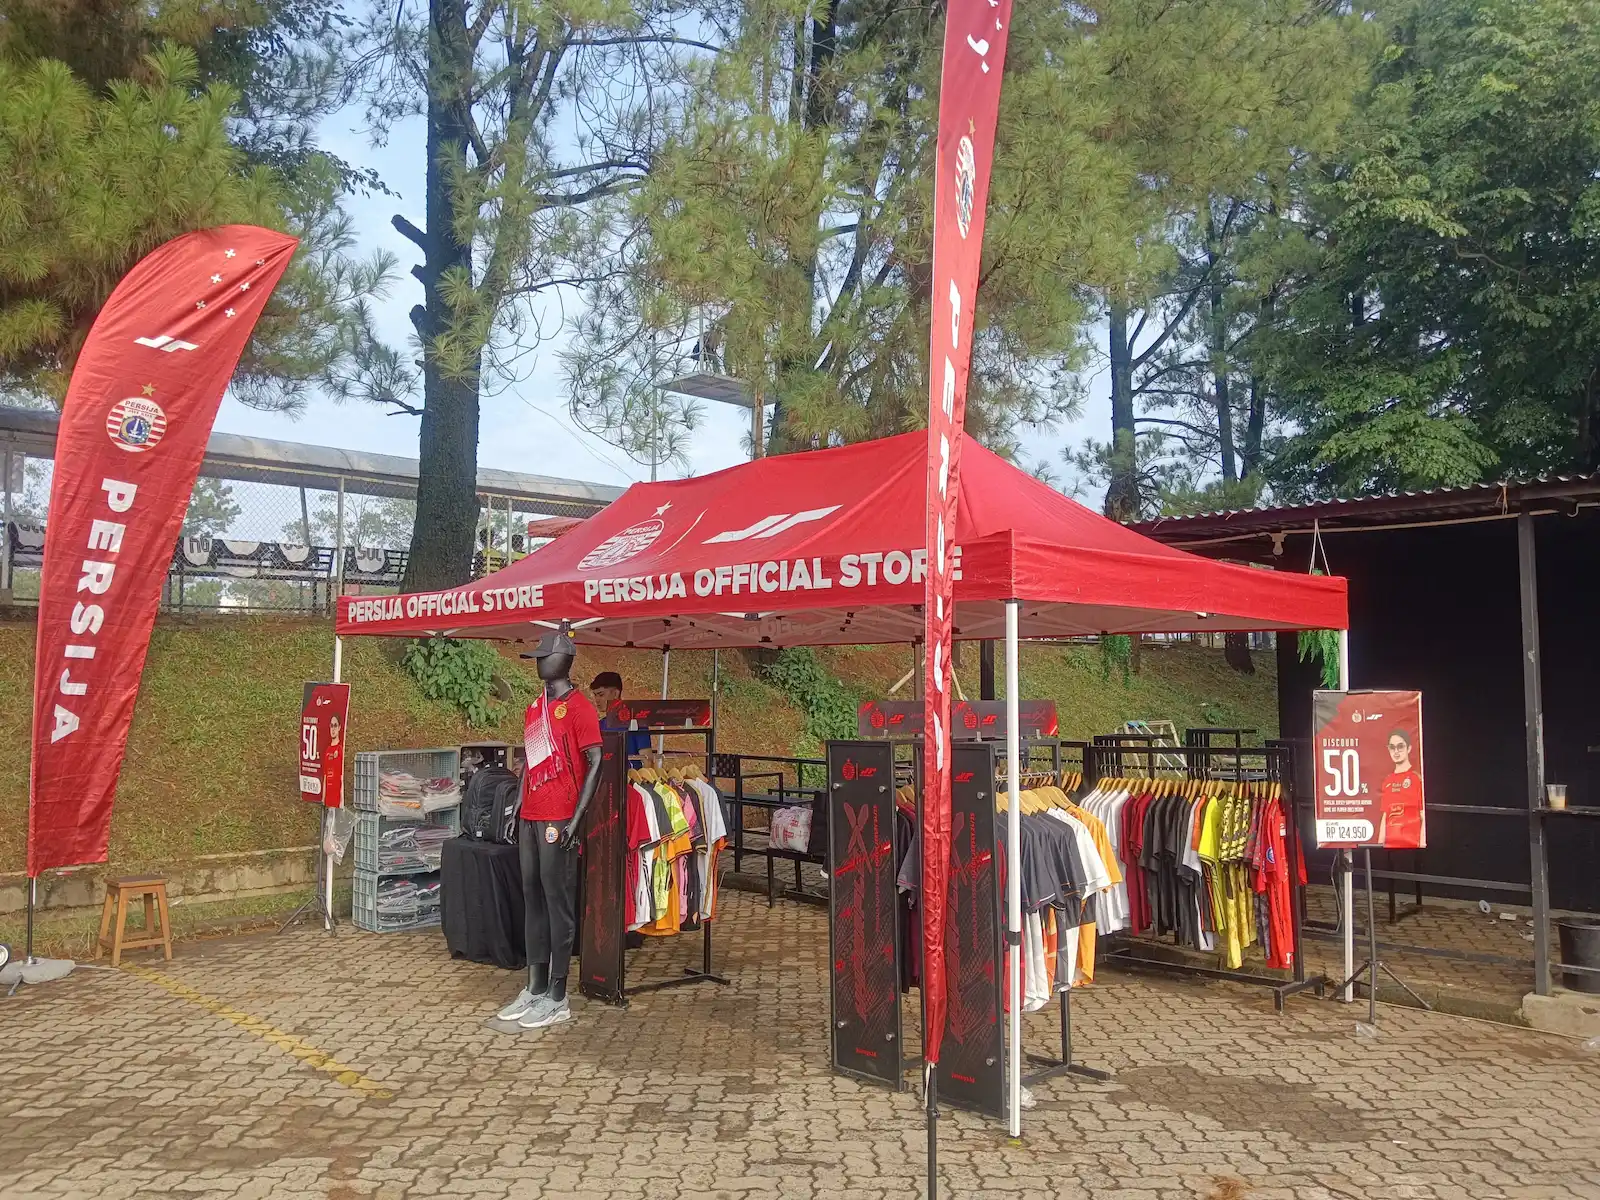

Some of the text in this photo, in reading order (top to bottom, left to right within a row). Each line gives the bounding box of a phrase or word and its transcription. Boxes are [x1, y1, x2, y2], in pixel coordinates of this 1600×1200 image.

[124, 400, 159, 414] PERSIJA
[584, 572, 687, 604] PERSIJA
[693, 557, 832, 596] OFFICIAL
[51, 478, 138, 744] PERSIJA
[347, 584, 544, 623] PERSIJA OFFICIAL STORE
[1322, 738, 1359, 747] DISCOUNT
[1326, 826, 1367, 839] RP 124.950
